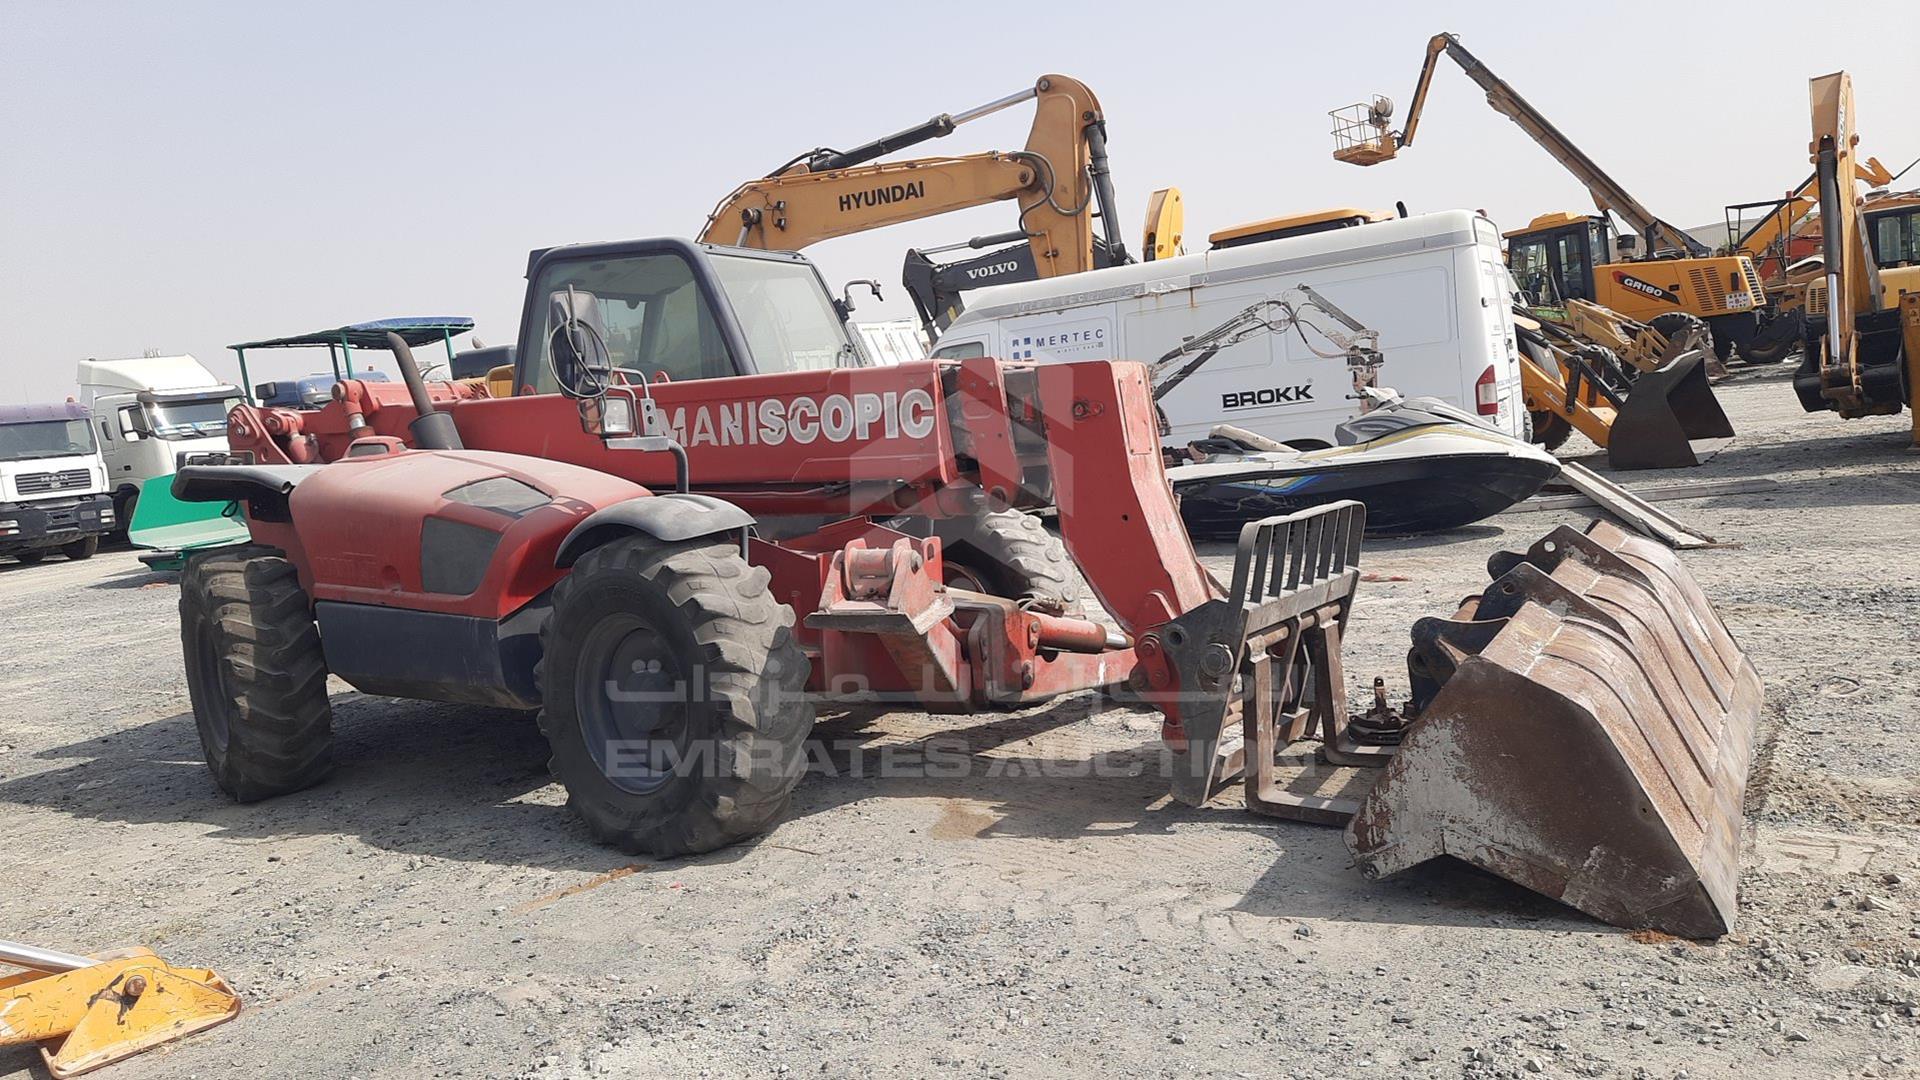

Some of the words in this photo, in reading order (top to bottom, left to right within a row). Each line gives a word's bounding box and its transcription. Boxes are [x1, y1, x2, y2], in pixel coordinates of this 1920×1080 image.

[838, 181, 925, 212] HYUNDAI
[966, 261, 1018, 279] VOLVO
[1623, 277, 1663, 297] GR180
[1036, 329, 1104, 348] MERTEC
[1222, 384, 1314, 408] BROKK
[654, 388, 935, 448] MANISCOPIC
[40, 474, 69, 482] MAN
